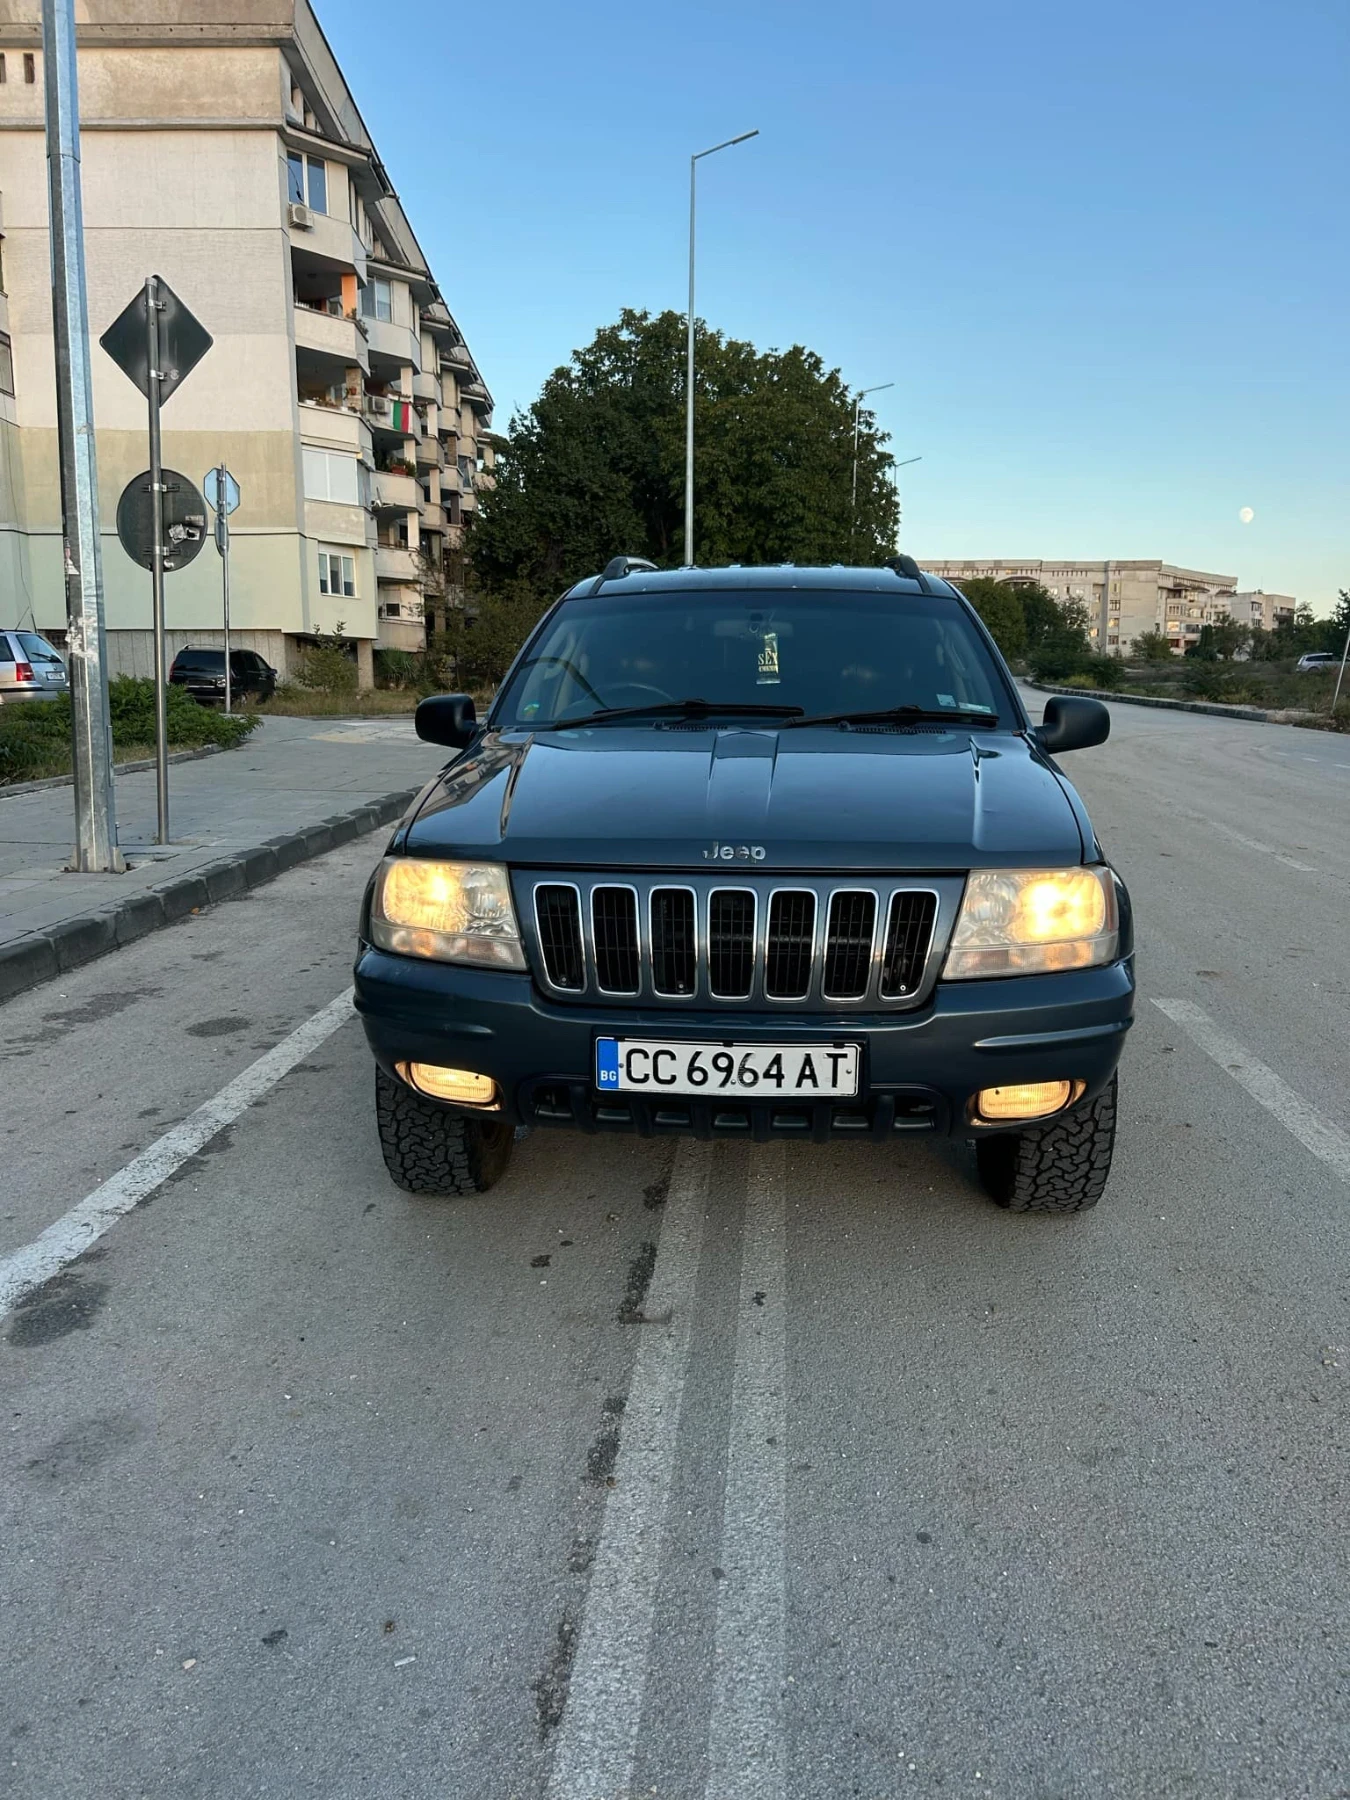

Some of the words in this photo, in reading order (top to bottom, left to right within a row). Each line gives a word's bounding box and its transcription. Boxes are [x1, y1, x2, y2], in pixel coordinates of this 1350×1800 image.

[703, 841, 766, 864] Jeep
[600, 1070, 617, 1081] BG
[626, 1048, 677, 1085] CC
[687, 1051, 785, 1088] 6964
[795, 1053, 848, 1088] AT
